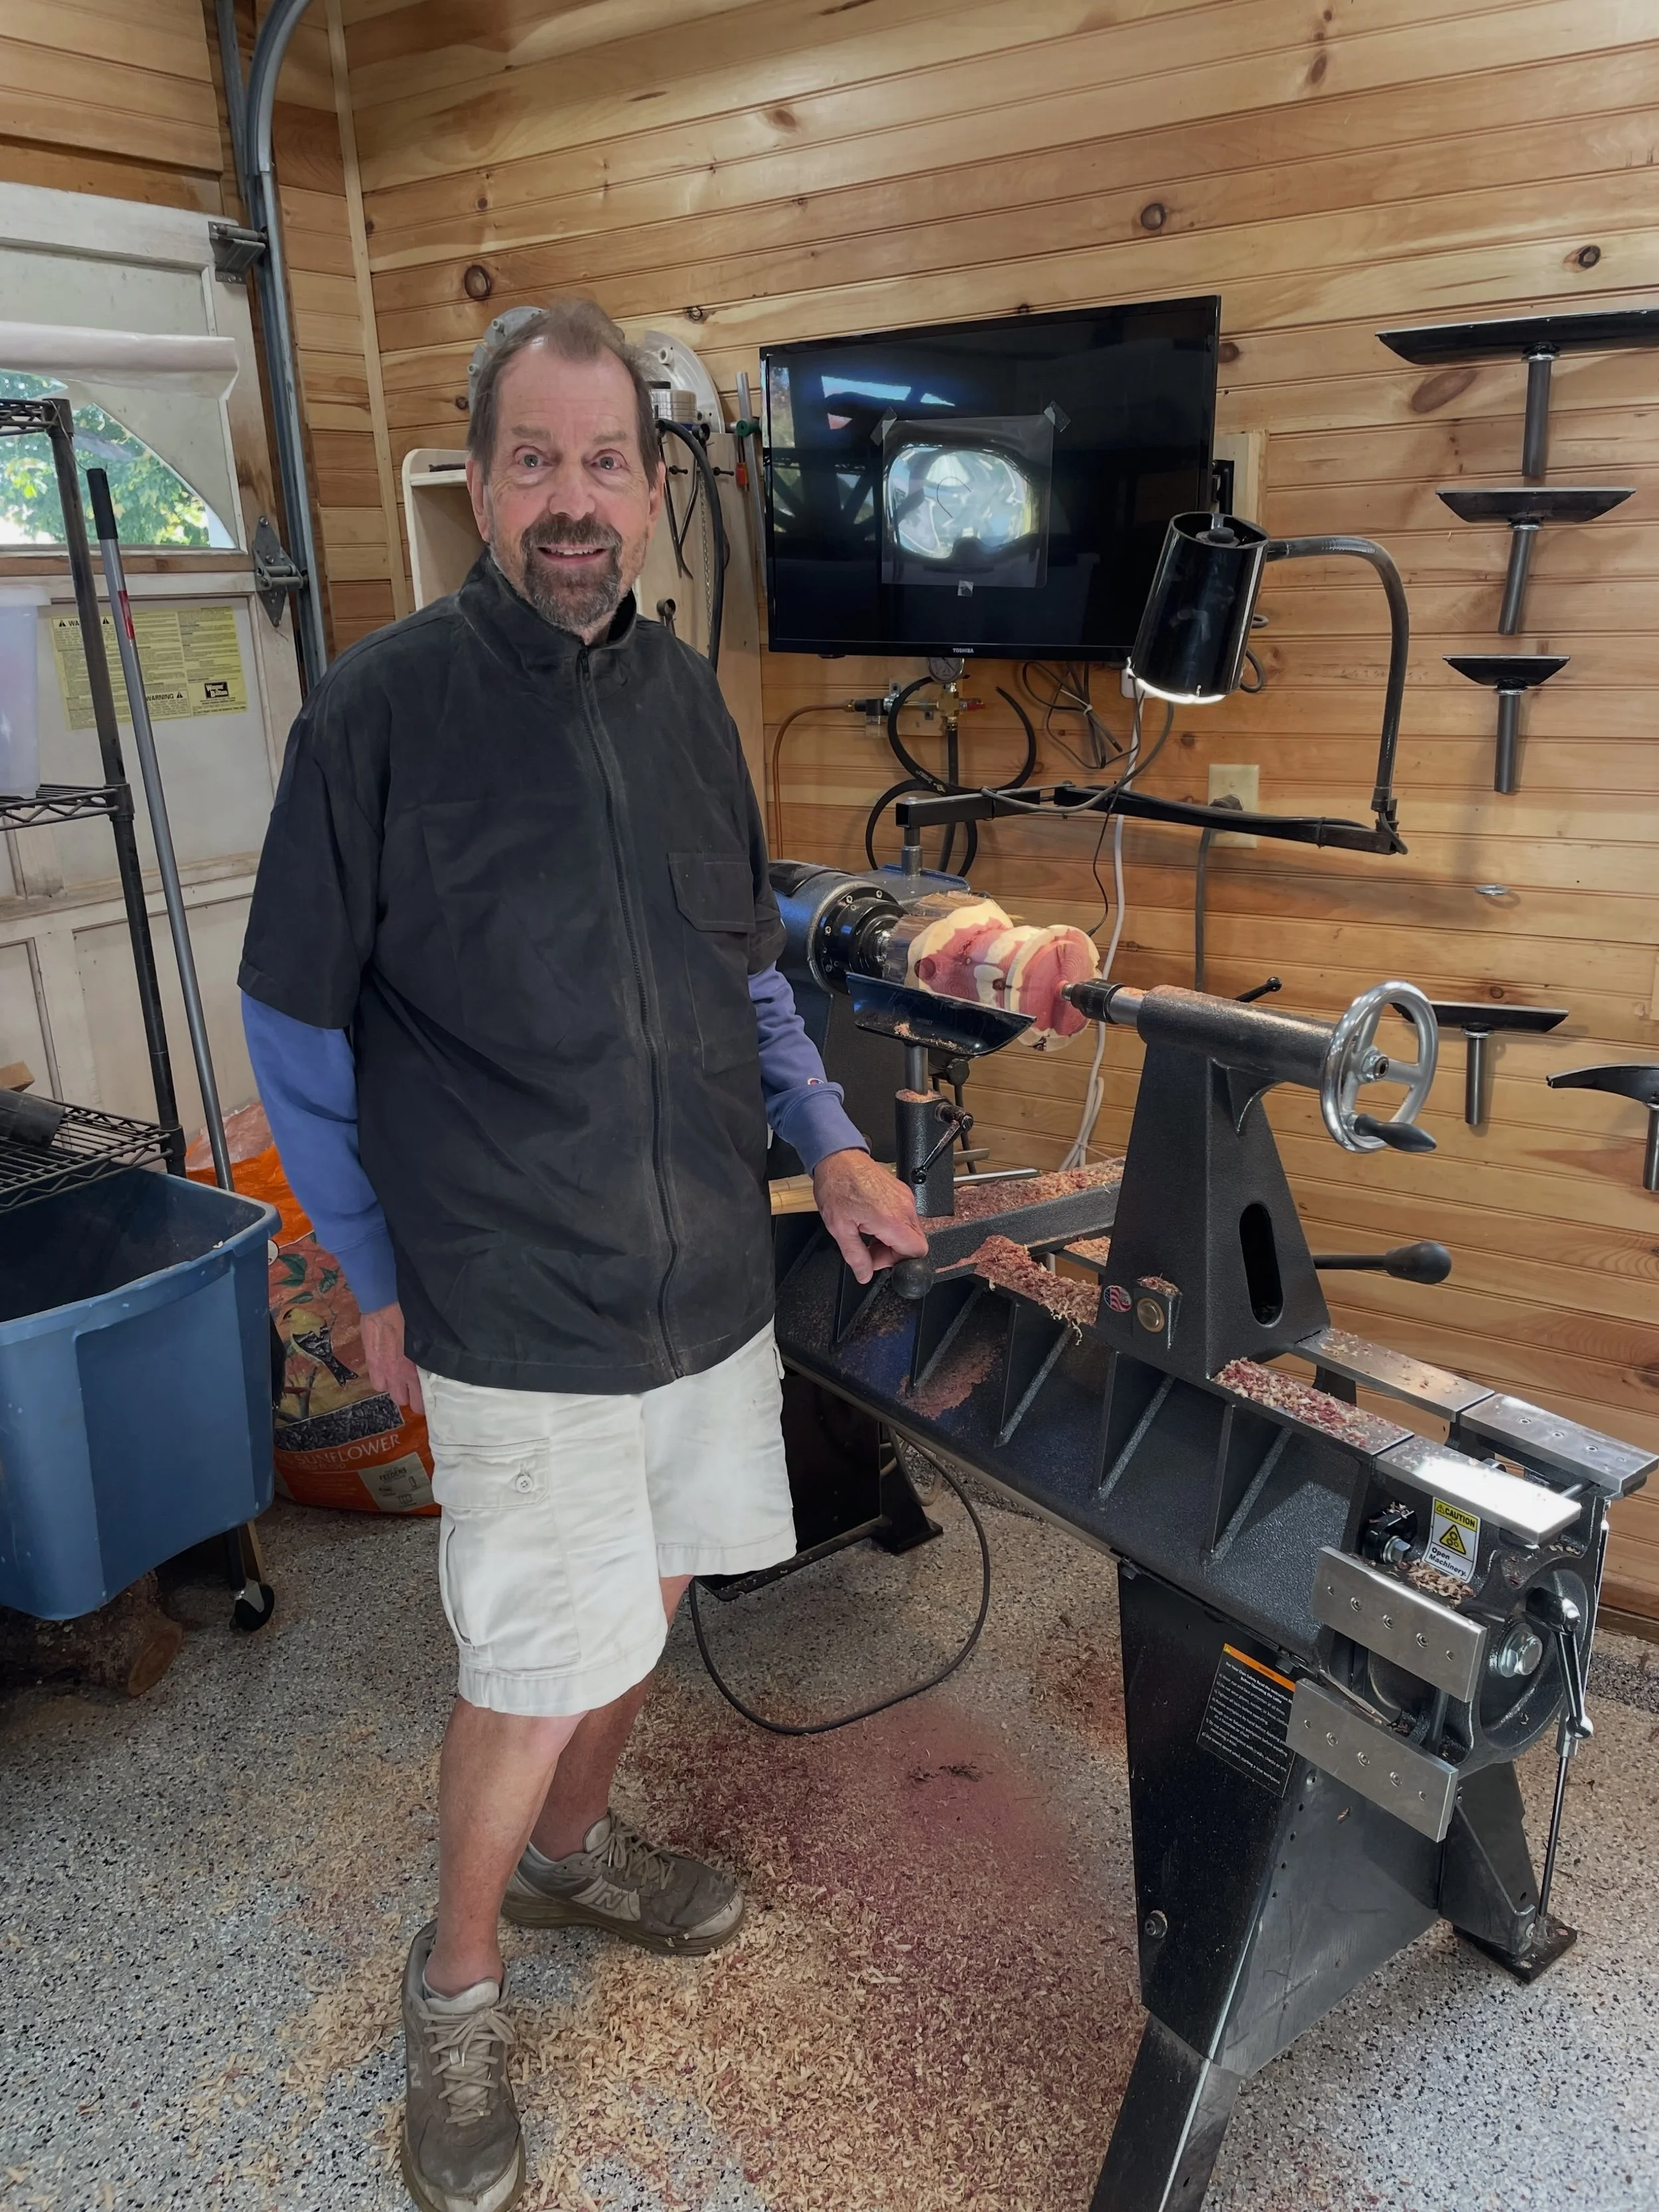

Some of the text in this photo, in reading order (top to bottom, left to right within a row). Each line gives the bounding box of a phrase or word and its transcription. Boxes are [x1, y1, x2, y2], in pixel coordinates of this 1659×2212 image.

[295, 1434, 401, 1464] SUNFLOWER
[1445, 1508, 1475, 1528] CAUTION
[1431, 1547, 1451, 1560] Open
[1428, 1554, 1467, 1577] Machinery.
